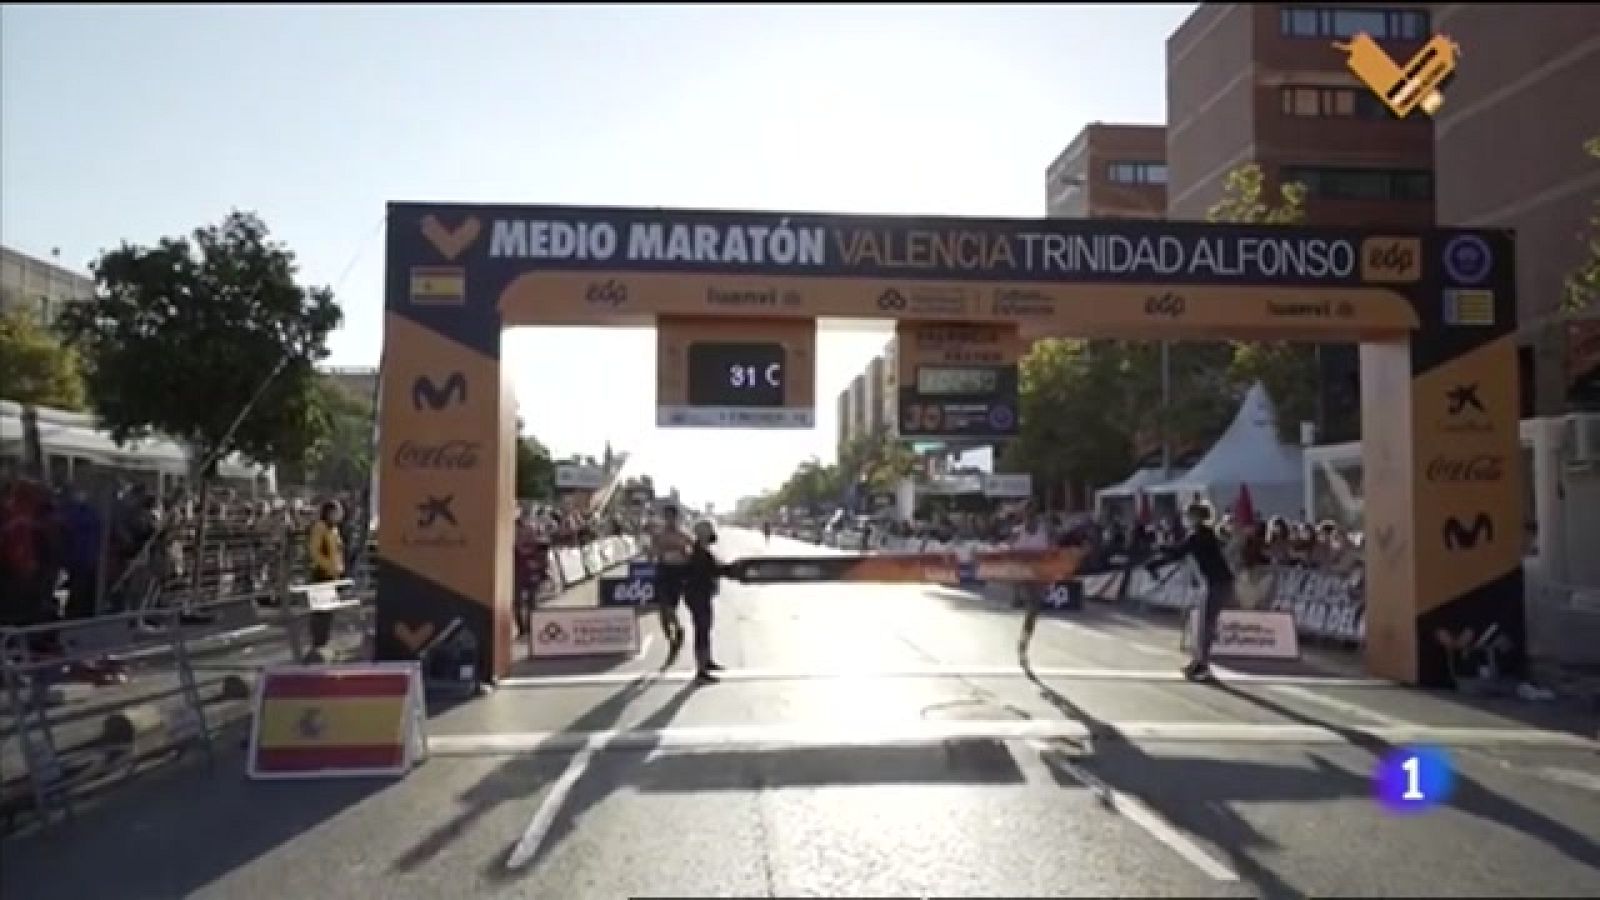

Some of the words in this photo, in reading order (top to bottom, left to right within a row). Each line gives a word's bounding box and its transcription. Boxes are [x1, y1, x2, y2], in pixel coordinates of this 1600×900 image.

[489, 219, 617, 260] MEDIO
[627, 218, 825, 265] MARATÓN
[836, 228, 1014, 267] VALENCIA
[1017, 234, 1182, 274] TRINIDAD
[1189, 237, 1355, 278] ALFONSO
[729, 365, 756, 386] 31
